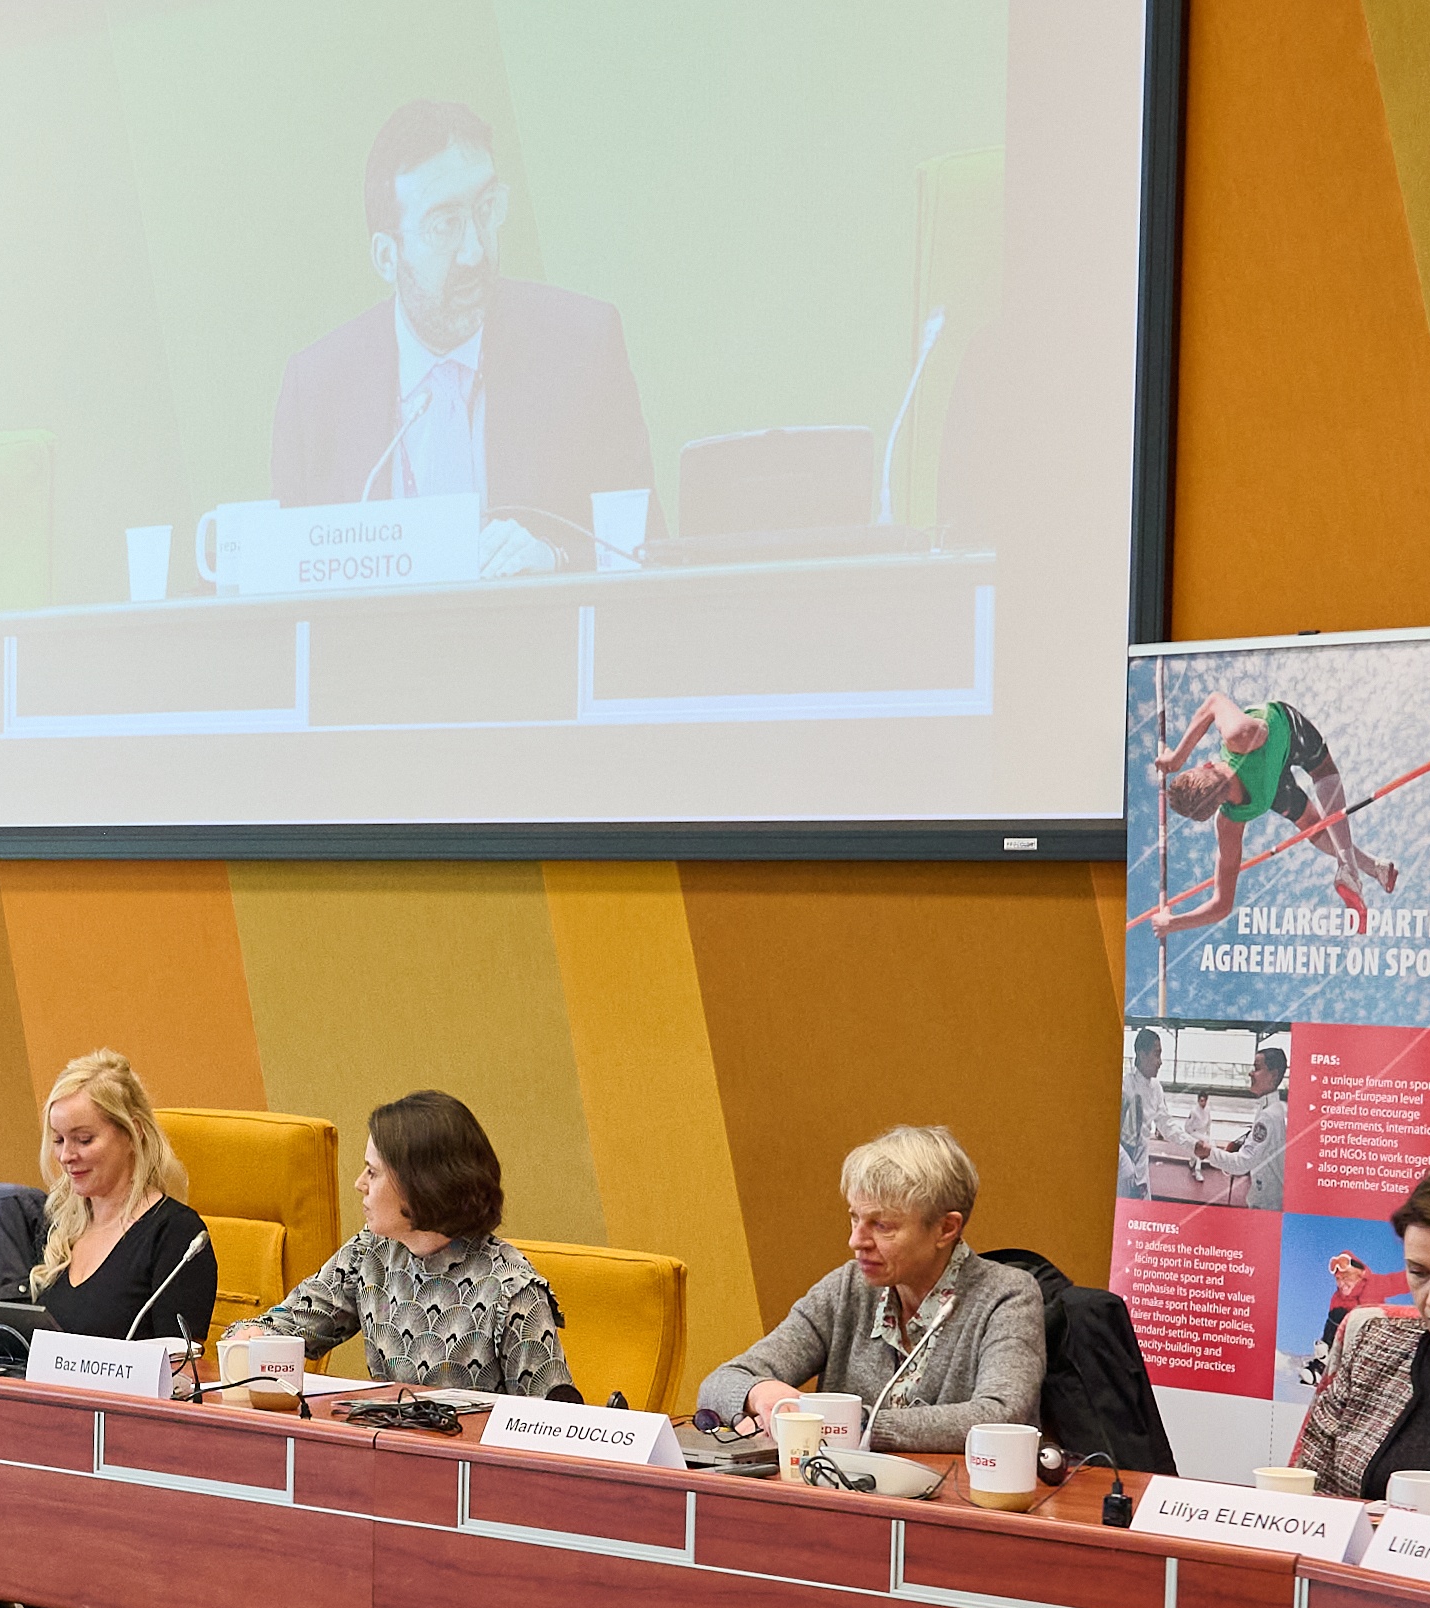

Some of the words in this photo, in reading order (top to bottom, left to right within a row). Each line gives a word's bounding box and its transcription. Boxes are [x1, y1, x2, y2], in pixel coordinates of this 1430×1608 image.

[308, 521, 404, 547] Gianluca
[297, 553, 413, 584] ESPOSITO
[1237, 906, 1358, 936] ENLARGED
[1200, 943, 1339, 974] AGREEMENT
[1346, 947, 1379, 976] ON
[1310, 1054, 1340, 1066] EPAS:
[1322, 1076, 1329, 1085] a
[1330, 1075, 1364, 1087] unique
[1365, 1075, 1393, 1088] forum
[1395, 1080, 1408, 1089] on
[1321, 1090, 1331, 1099] at
[1333, 1090, 1398, 1104] pan-European
[1400, 1093, 1424, 1105] level
[1321, 1104, 1357, 1116] created
[1359, 1106, 1368, 1116] to
[1370, 1108, 1420, 1121] encourage
[1320, 1119, 1384, 1133] governments,
[1320, 1134, 1345, 1145] sport
[1347, 1134, 1398, 1148] federations
[1319, 1148, 1338, 1158] and
[1340, 1148, 1367, 1160] NGOs
[1369, 1151, 1378, 1161] to
[1380, 1152, 1403, 1163] work
[1318, 1162, 1338, 1173] also
[1340, 1165, 1365, 1176] open
[1366, 1166, 1376, 1176] to
[1377, 1165, 1412, 1179] Council
[1317, 1178, 1379, 1191] non-member
[1381, 1181, 1410, 1194] States
[1127, 1220, 1179, 1234] OBJECTIVES:
[1135, 1240, 1143, 1249] to
[1145, 1240, 1175, 1253] address
[1177, 1243, 1192, 1254] the
[1193, 1244, 1243, 1260] challenges
[1134, 1252, 1158, 1267] facing
[1160, 1256, 1182, 1268] sport
[1184, 1258, 1192, 1268] in
[1194, 1259, 1227, 1273] Europe
[1229, 1263, 1255, 1277] today
[1133, 1268, 1141, 1277] to
[1143, 1269, 1179, 1282] promote
[1180, 1272, 1204, 1284] sport
[1205, 1275, 1224, 1286] and
[1133, 1282, 1175, 1295] emphasise
[1177, 1285, 1187, 1296] its
[1189, 1287, 1226, 1300] positive
[1227, 1291, 1255, 1303] values
[1132, 1295, 1140, 1305] to
[1141, 1297, 1164, 1308] make
[1165, 1300, 1188, 1311] sport
[1190, 1301, 1231, 1315] healthier
[1233, 1306, 1250, 1317] and
[1130, 1308, 1151, 1320] fairer
[1153, 1310, 1187, 1327] through
[1189, 1315, 1217, 1328] better
[1219, 1318, 1255, 1333] policies,
[1133, 1324, 1200, 1341] tandard-setting,
[1202, 1333, 1255, 1348] monitoring,
[1137, 1339, 1201, 1357] pacity-building
[1203, 1346, 1222, 1357] and
[54, 1356, 76, 1373] Baz
[79, 1360, 134, 1380] MOFFAT
[1141, 1351, 1168, 1366] hange
[1169, 1357, 1192, 1368] good
[1194, 1360, 1236, 1373] practices
[505, 1416, 562, 1439] Martine
[564, 1424, 636, 1447] DUCLOS
[1159, 1500, 1208, 1524] Liliya
[1215, 1508, 1327, 1539] ELENKOVA
